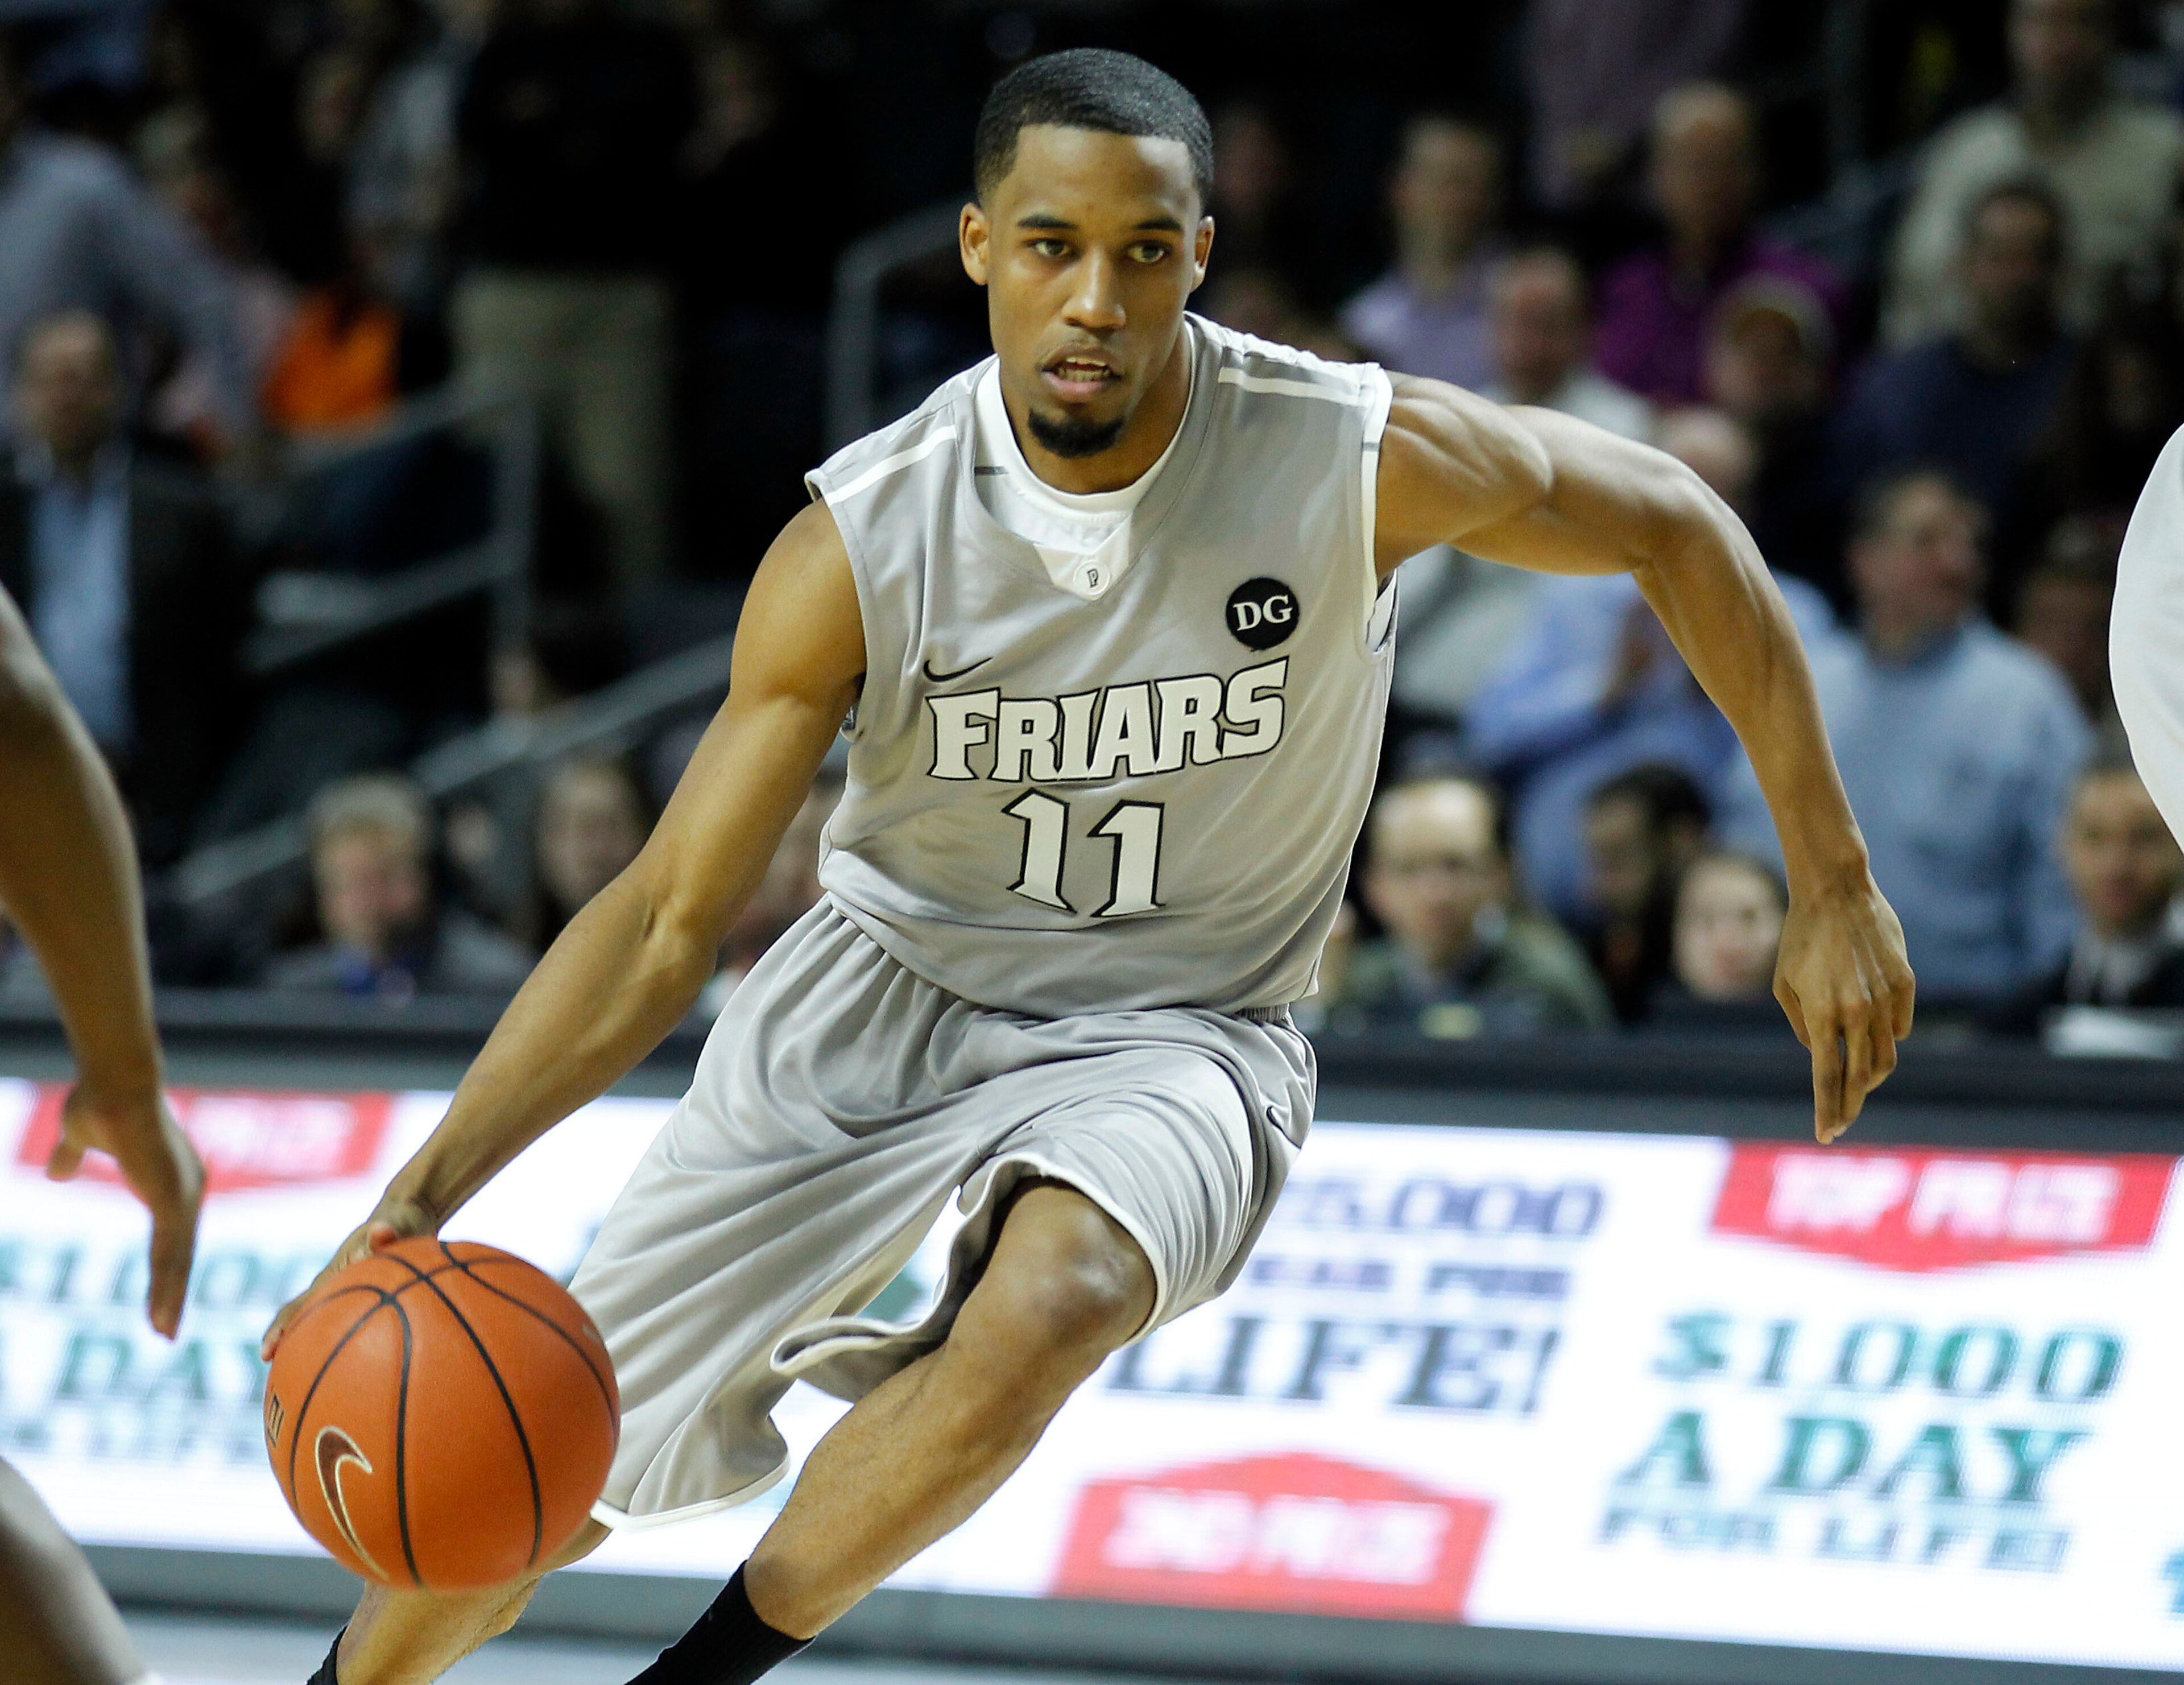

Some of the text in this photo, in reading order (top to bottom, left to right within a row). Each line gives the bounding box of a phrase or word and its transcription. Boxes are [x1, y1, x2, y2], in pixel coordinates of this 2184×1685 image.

[1232, 594, 1294, 631] DG
[925, 656, 1289, 783] FRIARS
[1000, 787, 1166, 918] 11
[1607, 1410, 2096, 1503] A DAY
